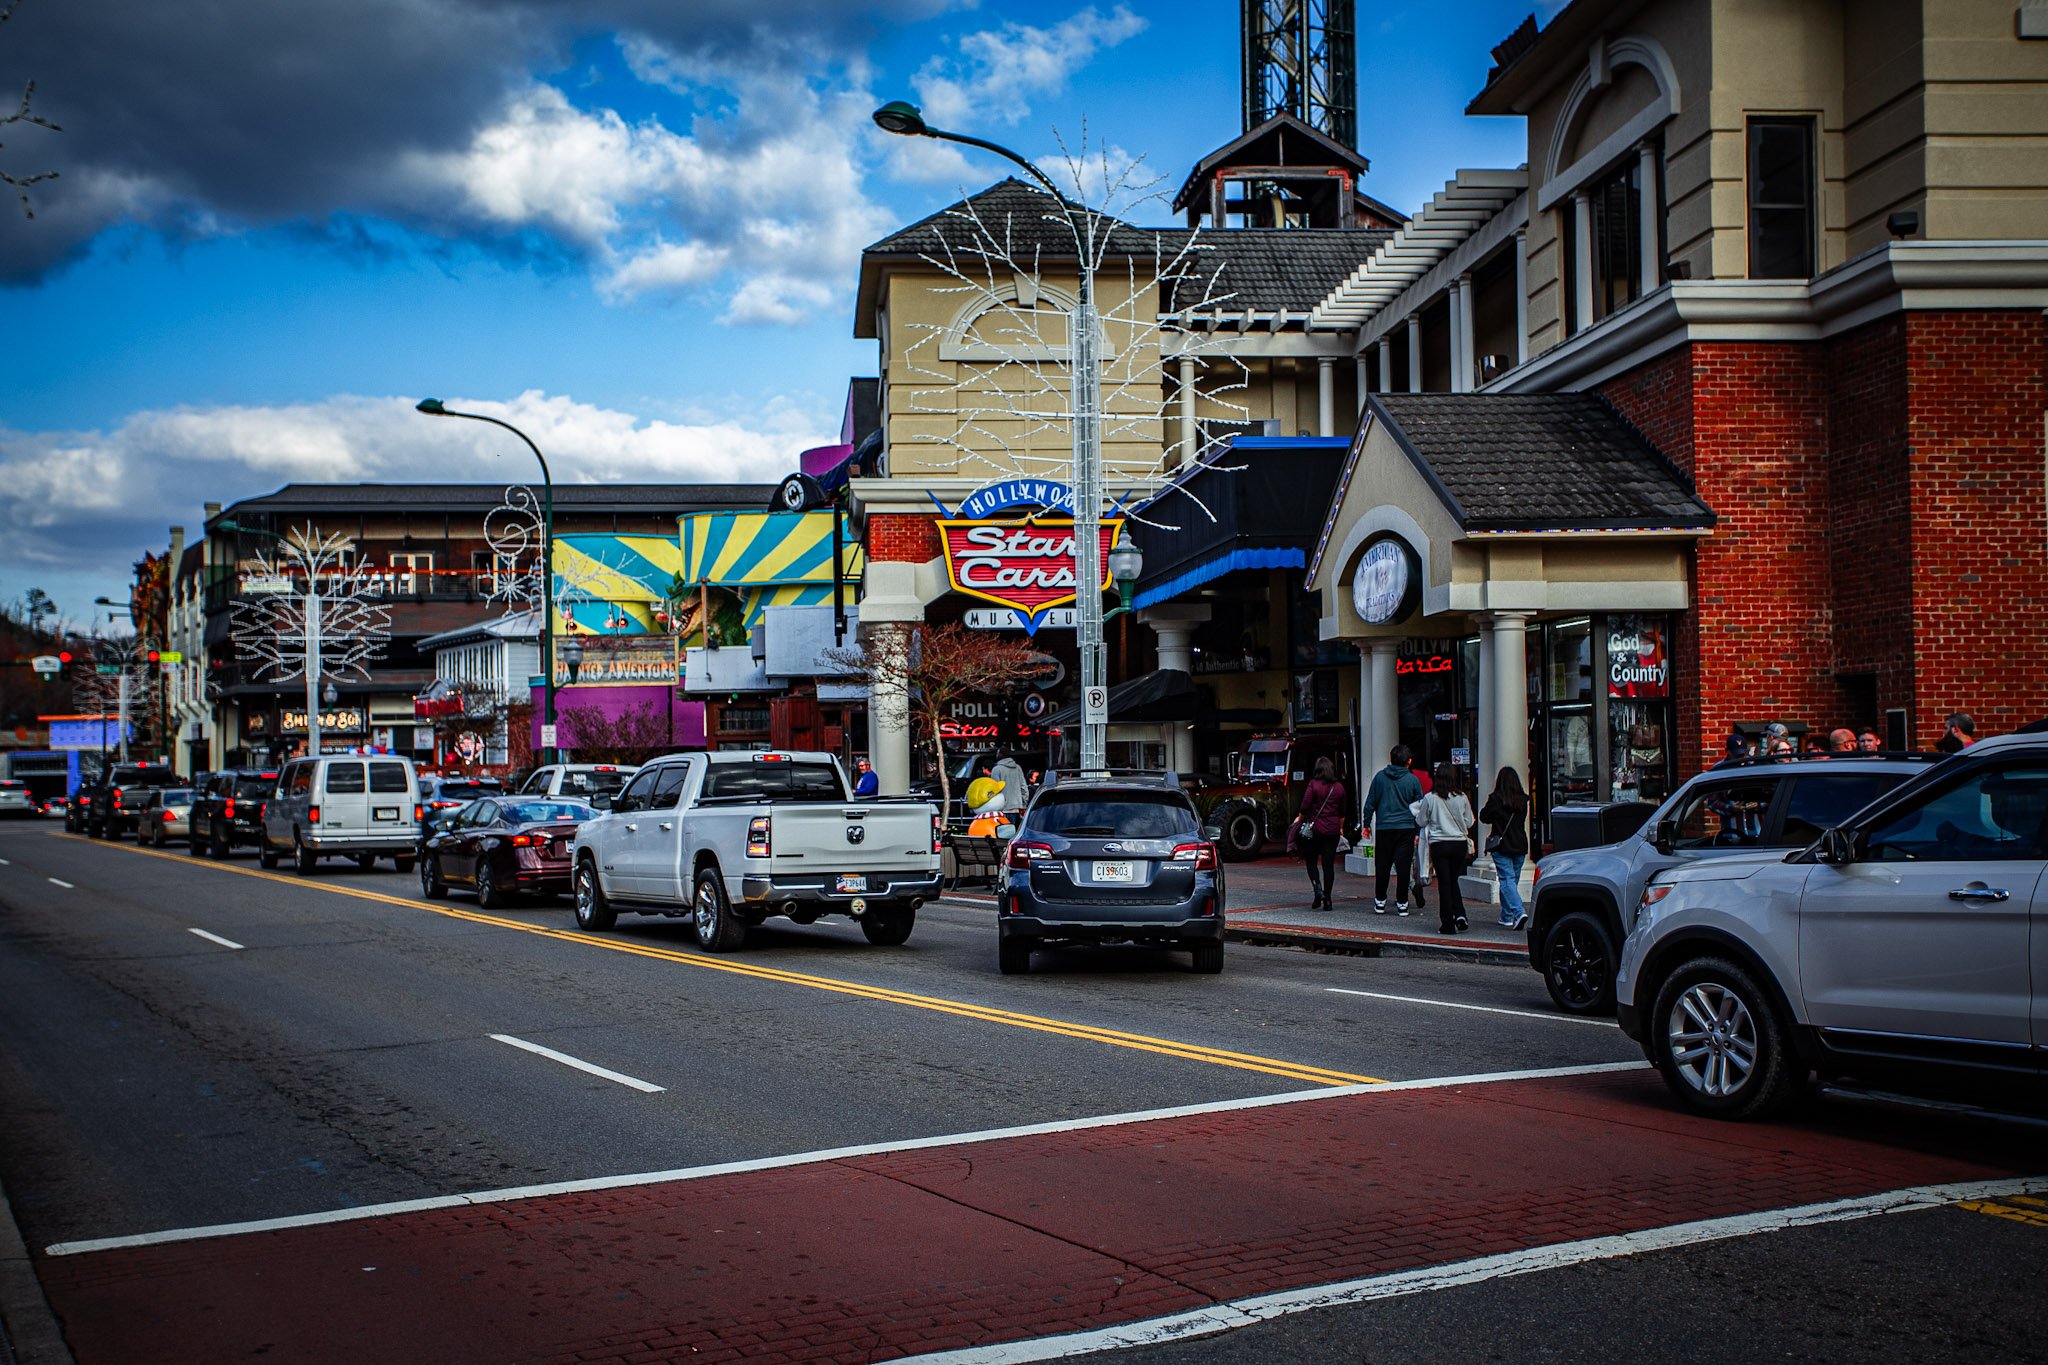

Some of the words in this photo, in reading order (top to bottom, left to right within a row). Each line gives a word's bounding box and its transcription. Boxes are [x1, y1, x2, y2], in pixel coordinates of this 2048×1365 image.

[969, 483, 1077, 515] HOLLYWOO
[955, 526, 1077, 558] Star
[960, 557, 1077, 589] Cars
[970, 611, 1073, 626] MUSEU
[1610, 633, 1640, 651] God
[1617, 652, 1628, 663] &
[555, 660, 604, 683] HANTED
[607, 656, 676, 681] ADVENTURE
[1610, 663, 1667, 686] Country
[283, 711, 325, 730] SMIH
[938, 722, 999, 738] Star
